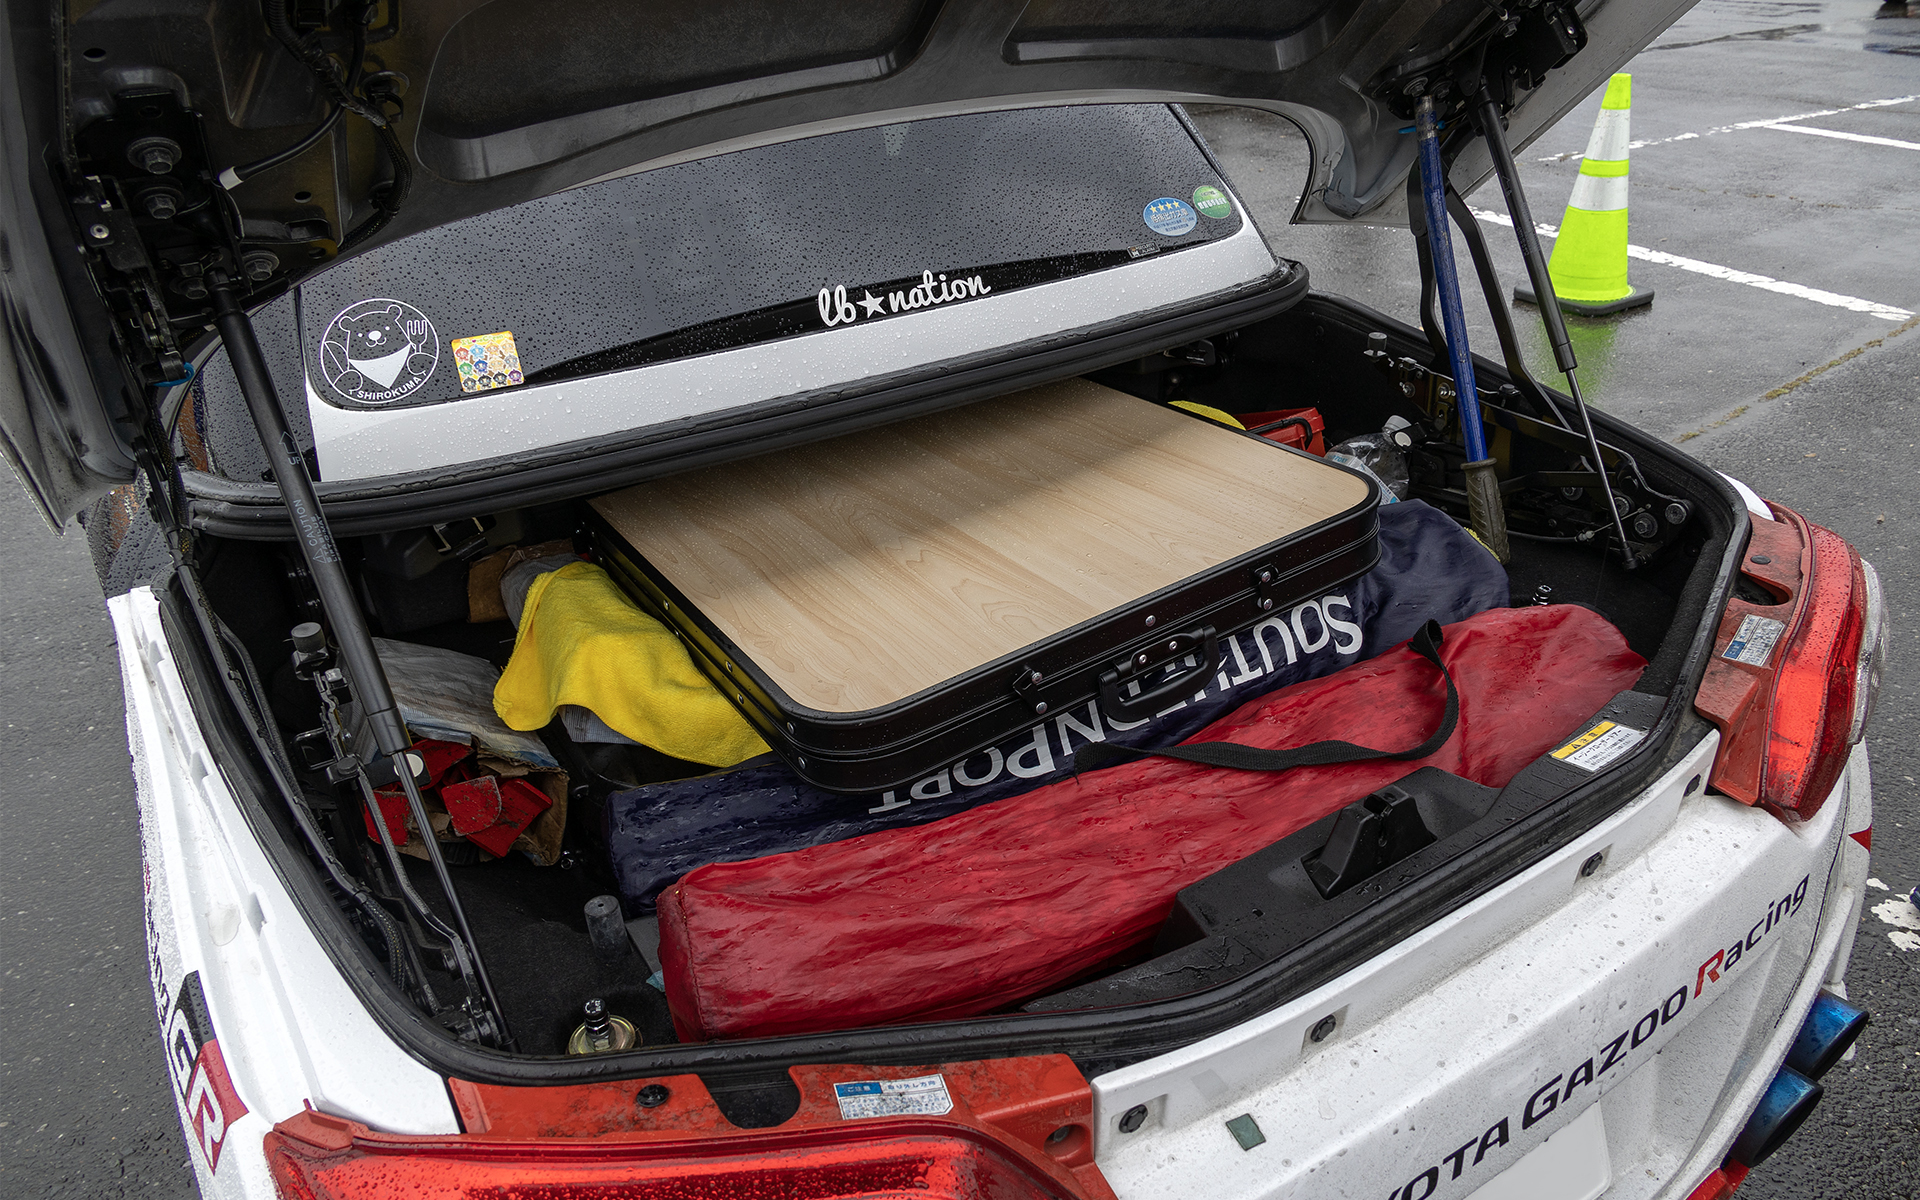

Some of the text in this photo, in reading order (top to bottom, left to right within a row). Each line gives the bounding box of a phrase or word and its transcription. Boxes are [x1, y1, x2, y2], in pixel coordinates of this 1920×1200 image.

[888, 269, 992, 313] nation
[357, 376, 422, 400] SHIROKUMA
[288, 456, 304, 466] UP
[293, 499, 318, 547] CAUTION
[310, 515, 333, 563] STABILUS
[1522, 984, 1688, 1131] GAZOO
[1693, 873, 1810, 1000] Racing
